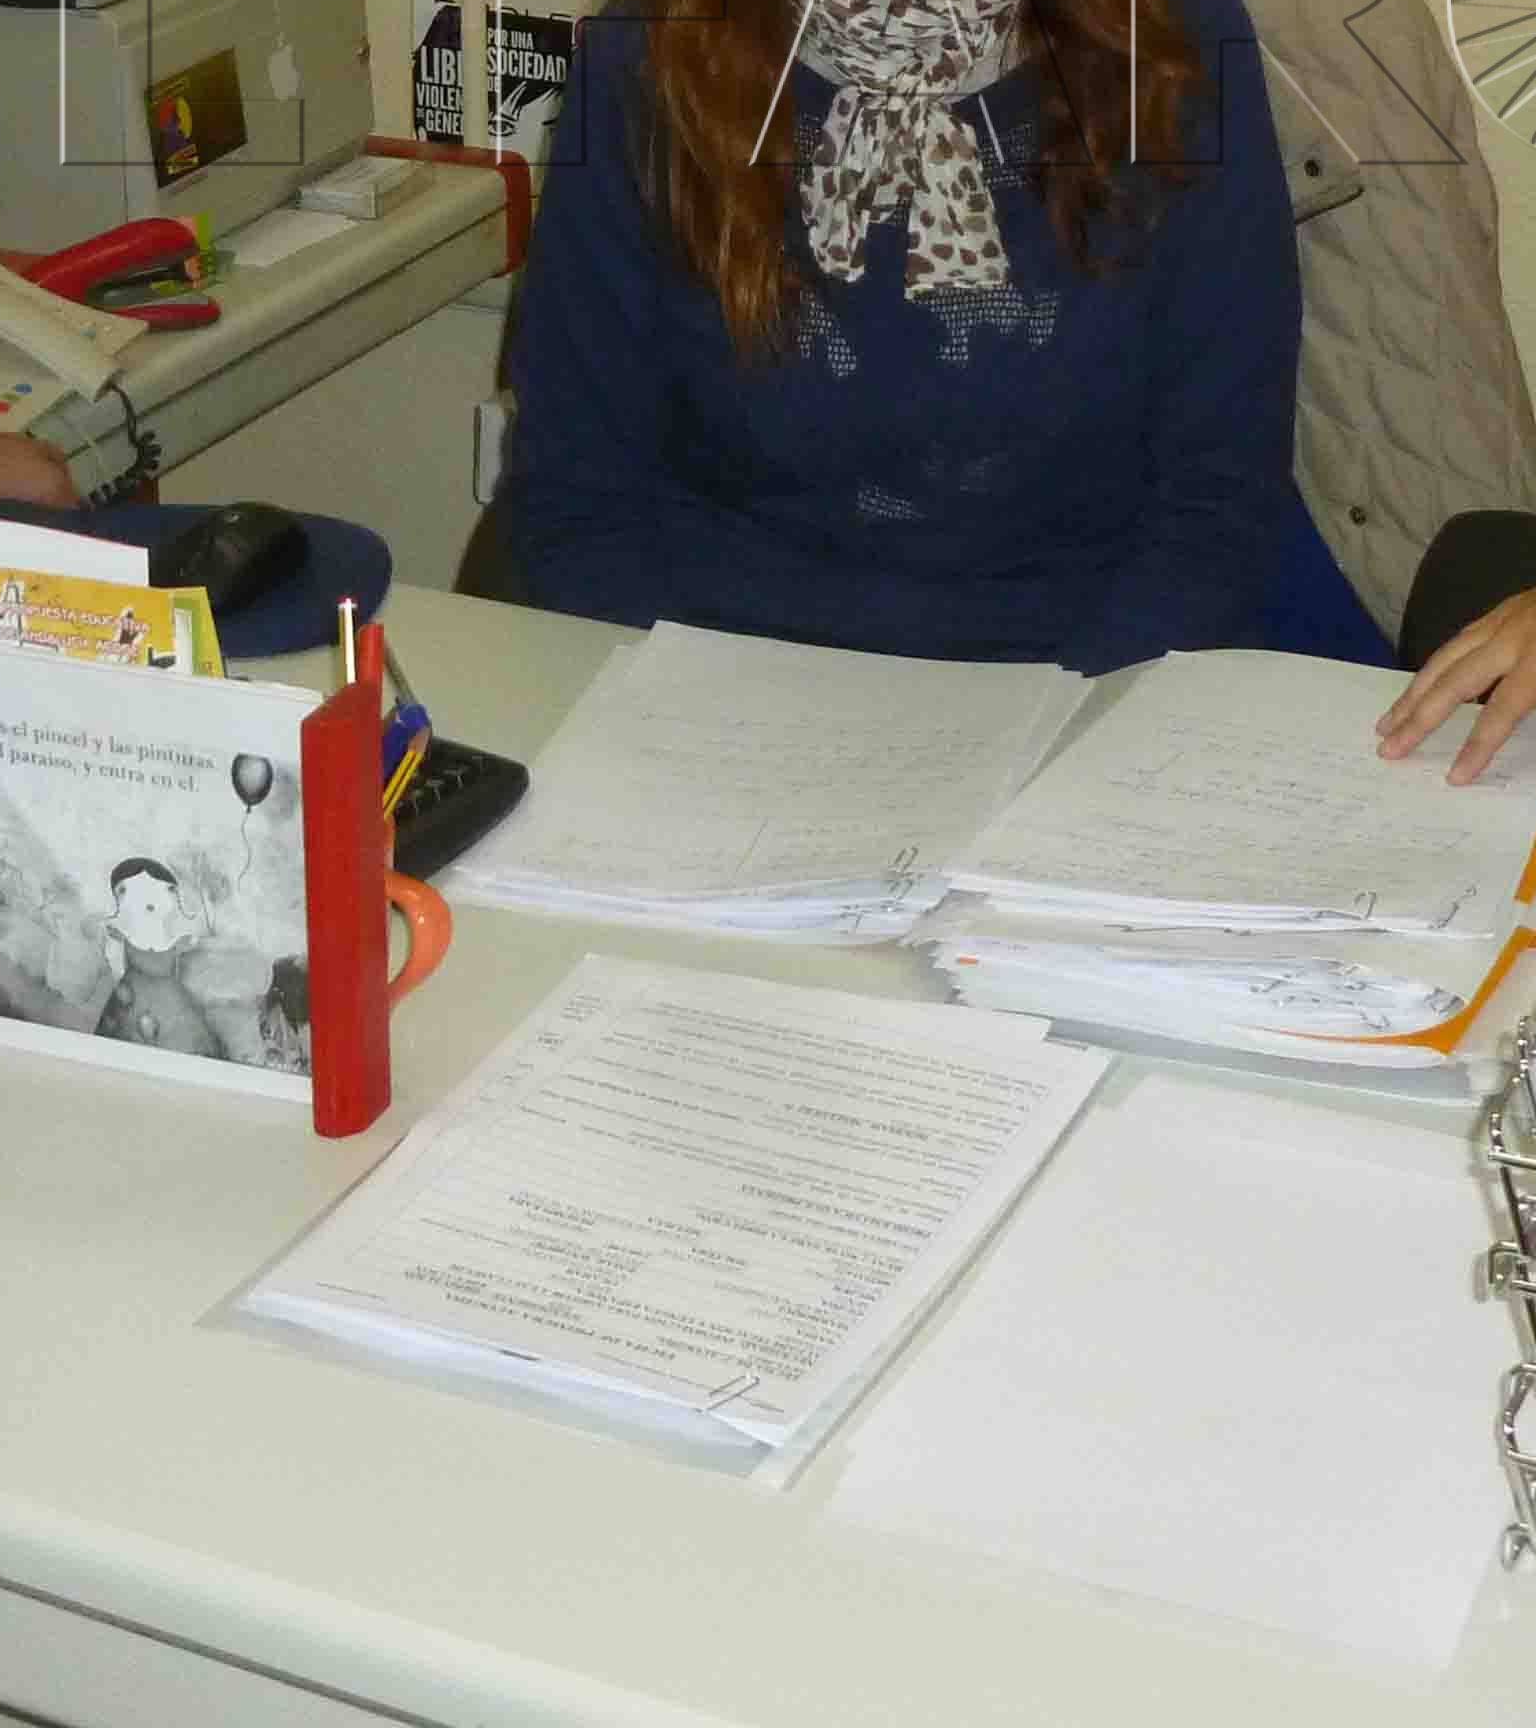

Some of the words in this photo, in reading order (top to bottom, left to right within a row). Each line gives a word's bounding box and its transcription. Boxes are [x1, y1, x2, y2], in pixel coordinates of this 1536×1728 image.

[487, 26, 509, 47] POR
[511, 31, 534, 50] UNA
[420, 45, 464, 87] LIB
[487, 46, 567, 82] SOCIEDAD
[415, 81, 464, 113] VIOLEN
[425, 108, 464, 135] GENE
[12, 721, 28, 738] el
[32, 725, 88, 749] pincel
[93, 735, 104, 754] y
[109, 735, 133, 755] las
[83, 758, 93, 777] y
[98, 761, 145, 785] entra
[150, 772, 173, 789] en
